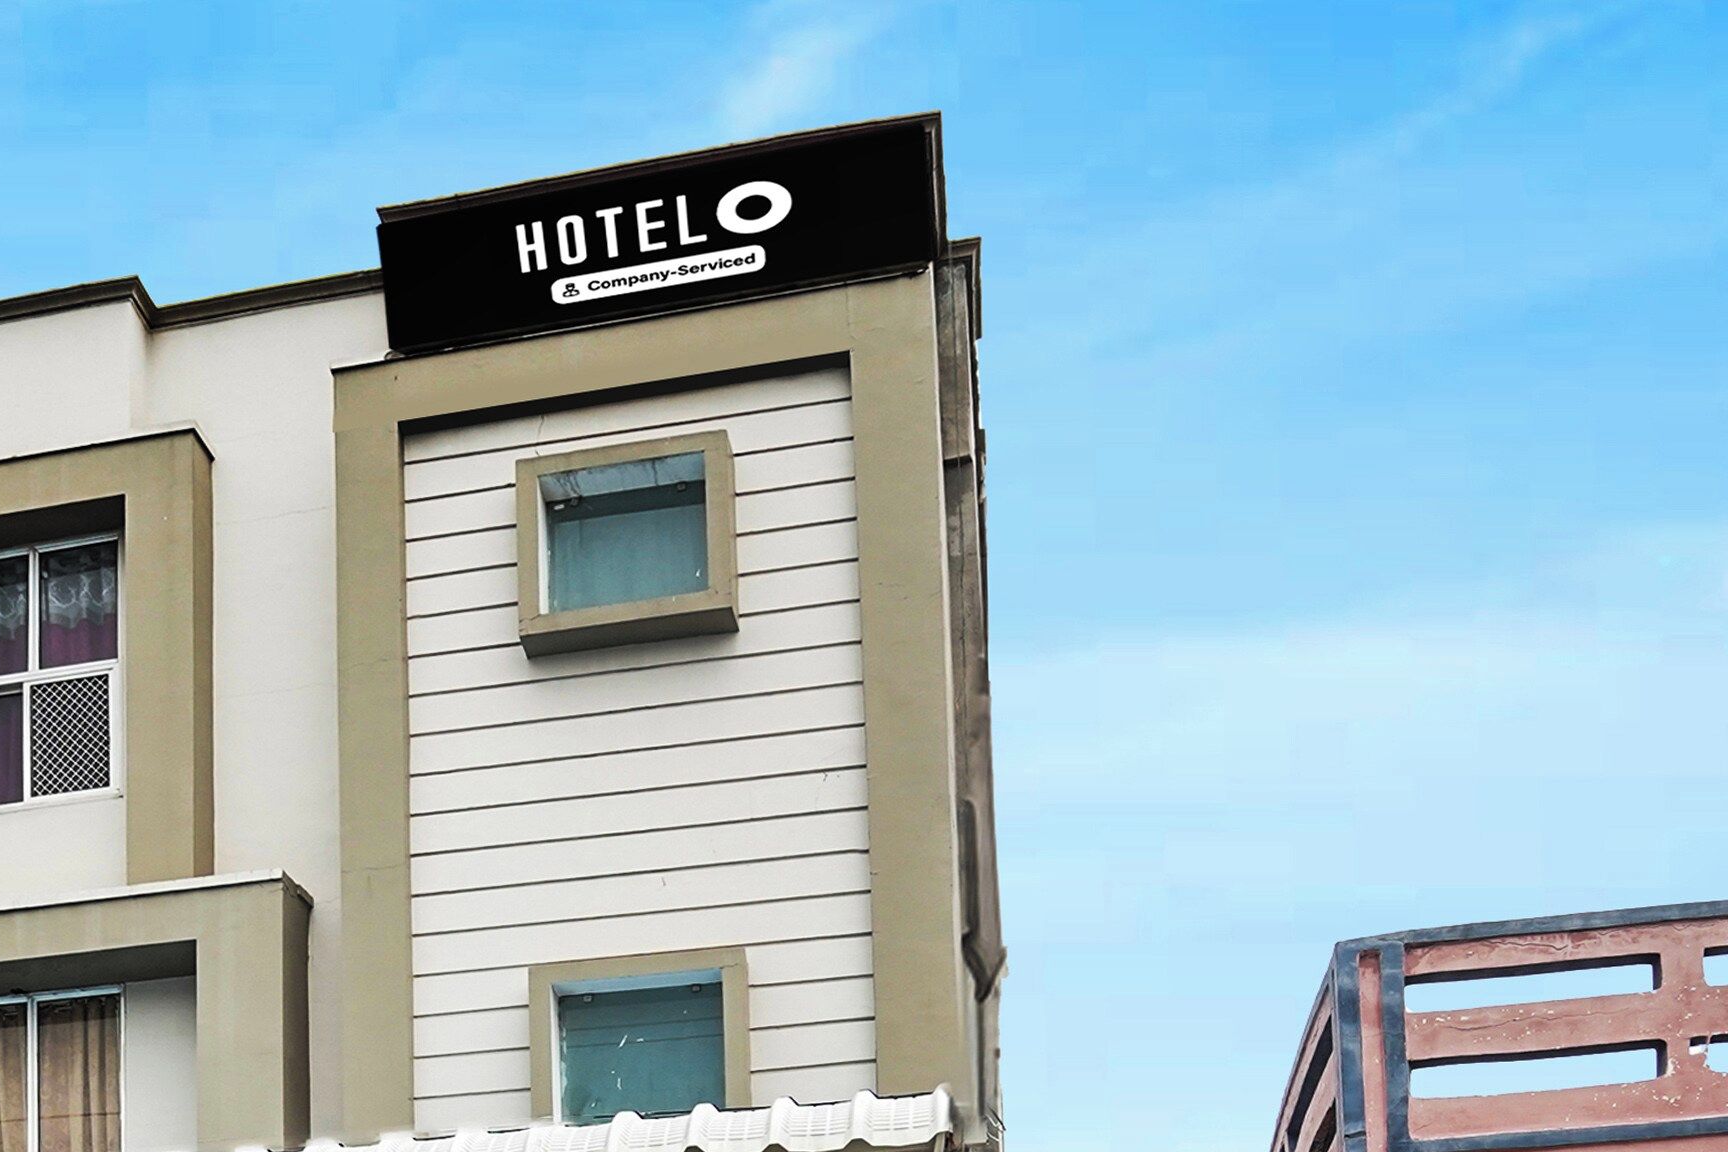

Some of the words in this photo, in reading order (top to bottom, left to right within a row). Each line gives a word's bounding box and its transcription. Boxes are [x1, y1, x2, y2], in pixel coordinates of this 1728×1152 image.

[515, 194, 708, 273] HOTEL
[716, 180, 793, 234] O
[587, 252, 756, 291] Company-Serviced
